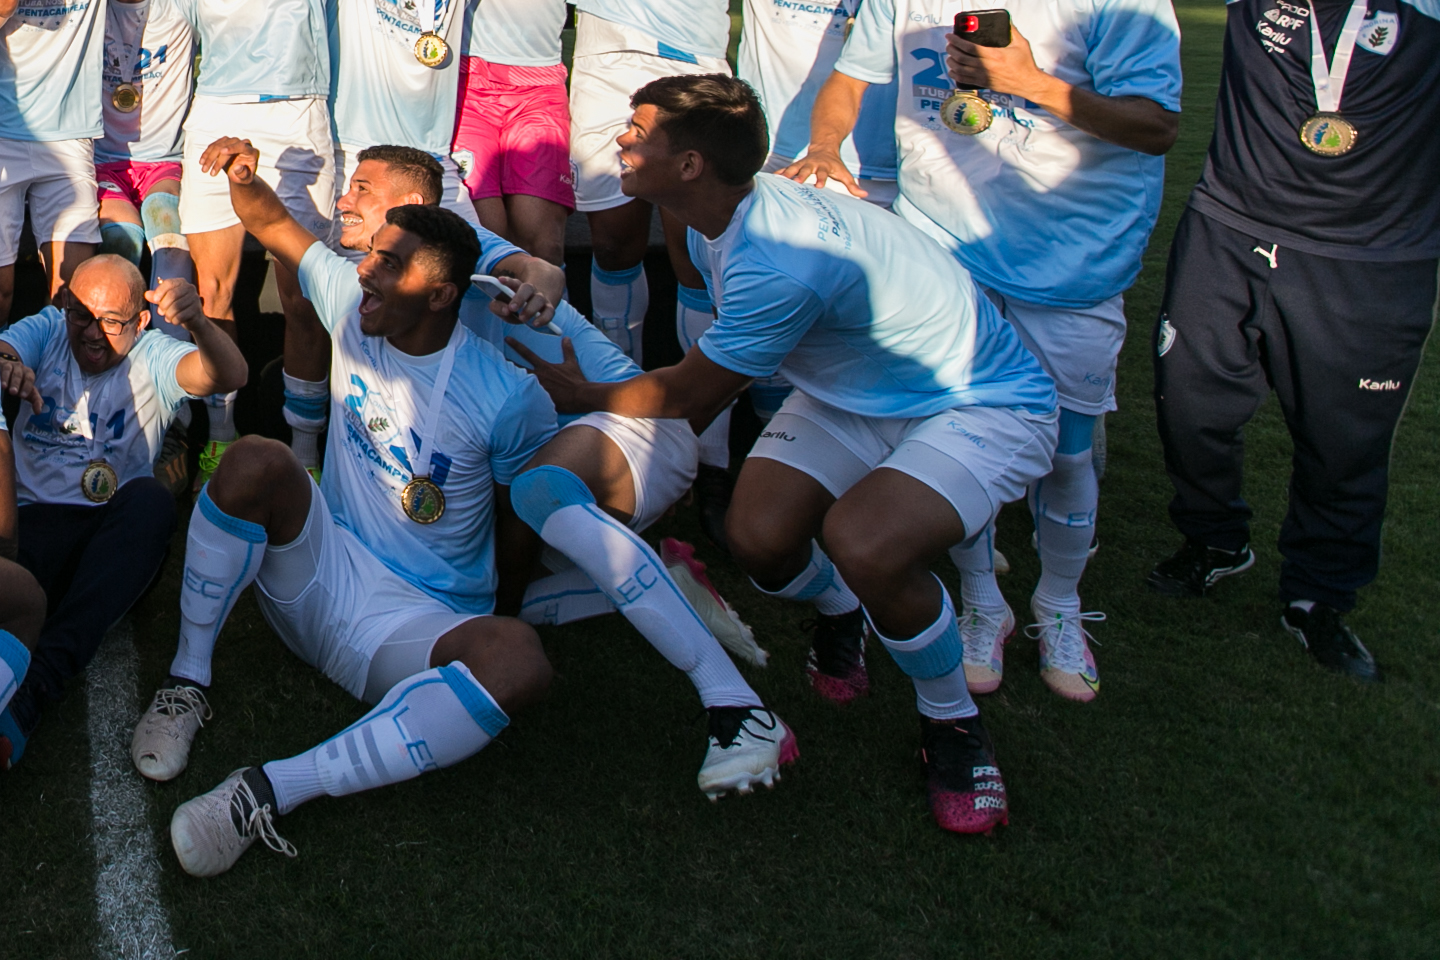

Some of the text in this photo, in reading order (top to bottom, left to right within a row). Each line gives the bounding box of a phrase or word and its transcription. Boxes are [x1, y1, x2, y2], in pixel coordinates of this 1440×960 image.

[1257, 20, 1293, 45] Karilu
[982, 93, 1010, 105] SSO
[1359, 378, 1400, 390] Karilu
